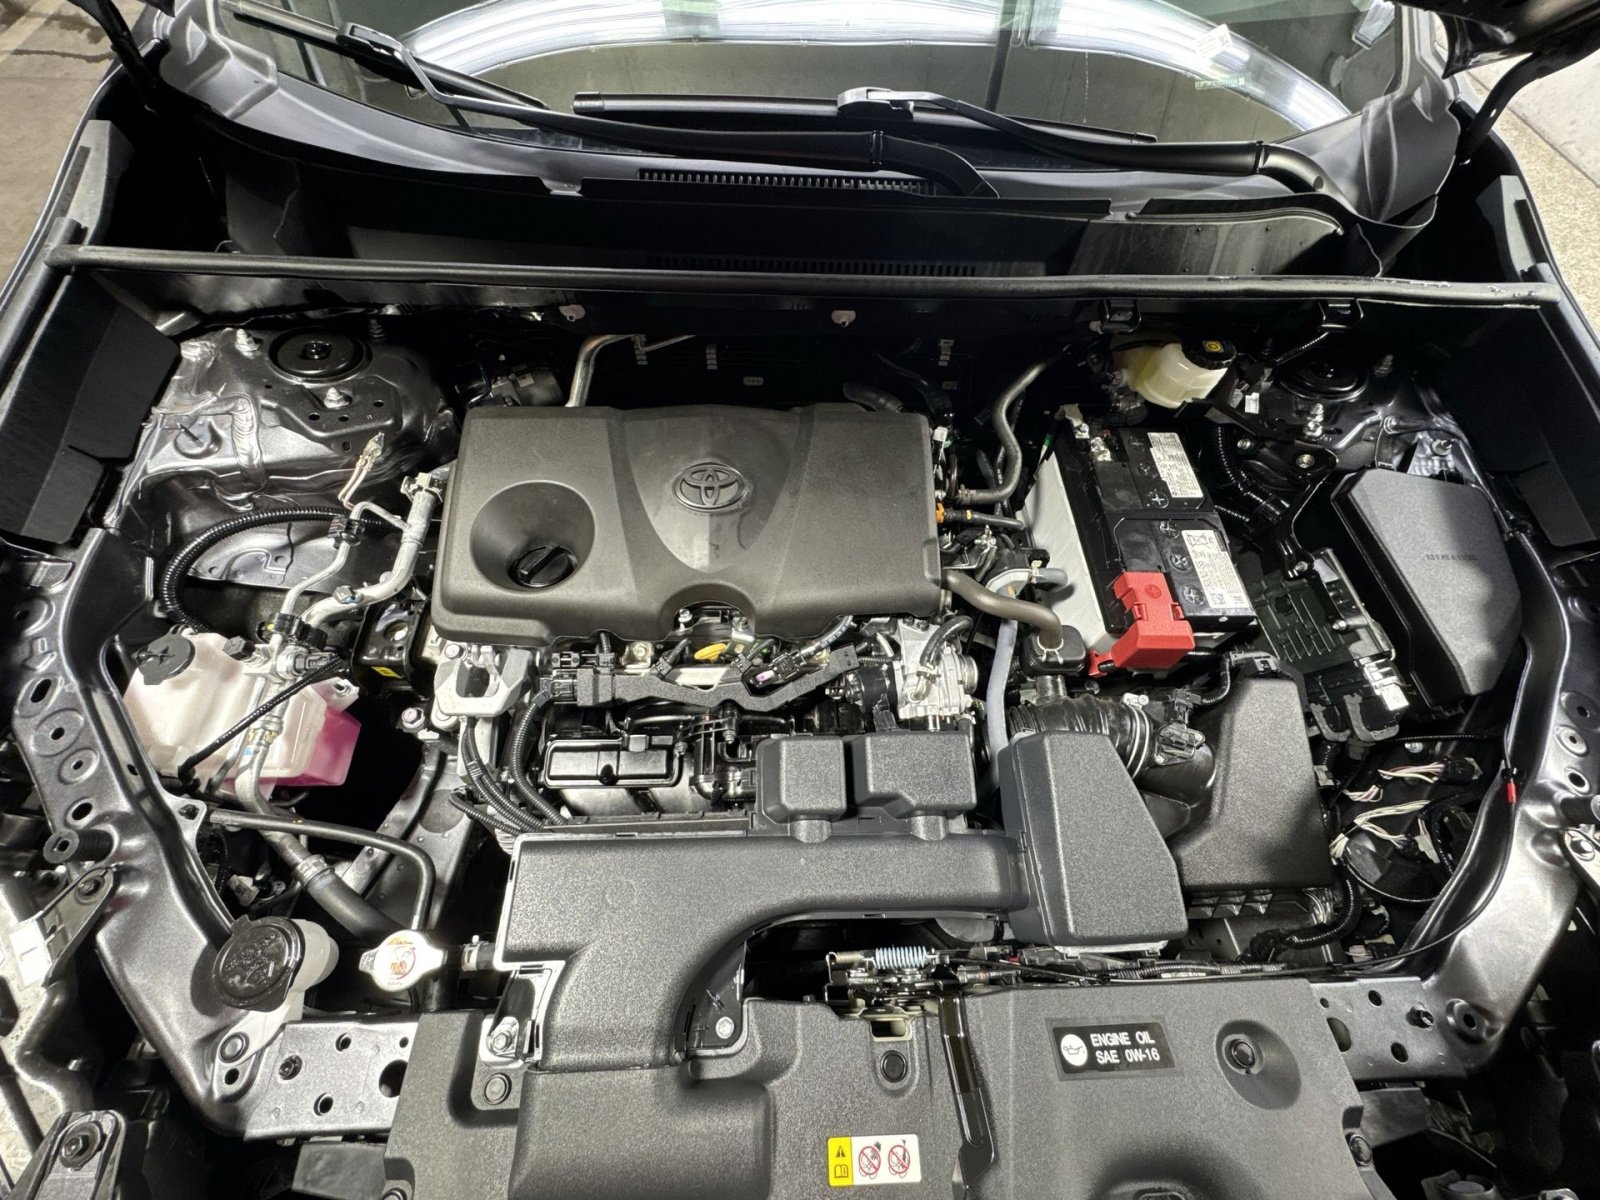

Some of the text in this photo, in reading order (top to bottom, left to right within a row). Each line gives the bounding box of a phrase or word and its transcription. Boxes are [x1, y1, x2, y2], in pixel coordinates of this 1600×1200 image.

[1090, 1031, 1155, 1047] ENGINE OIL
[1095, 1048, 1160, 1064] SAE 0W-16
